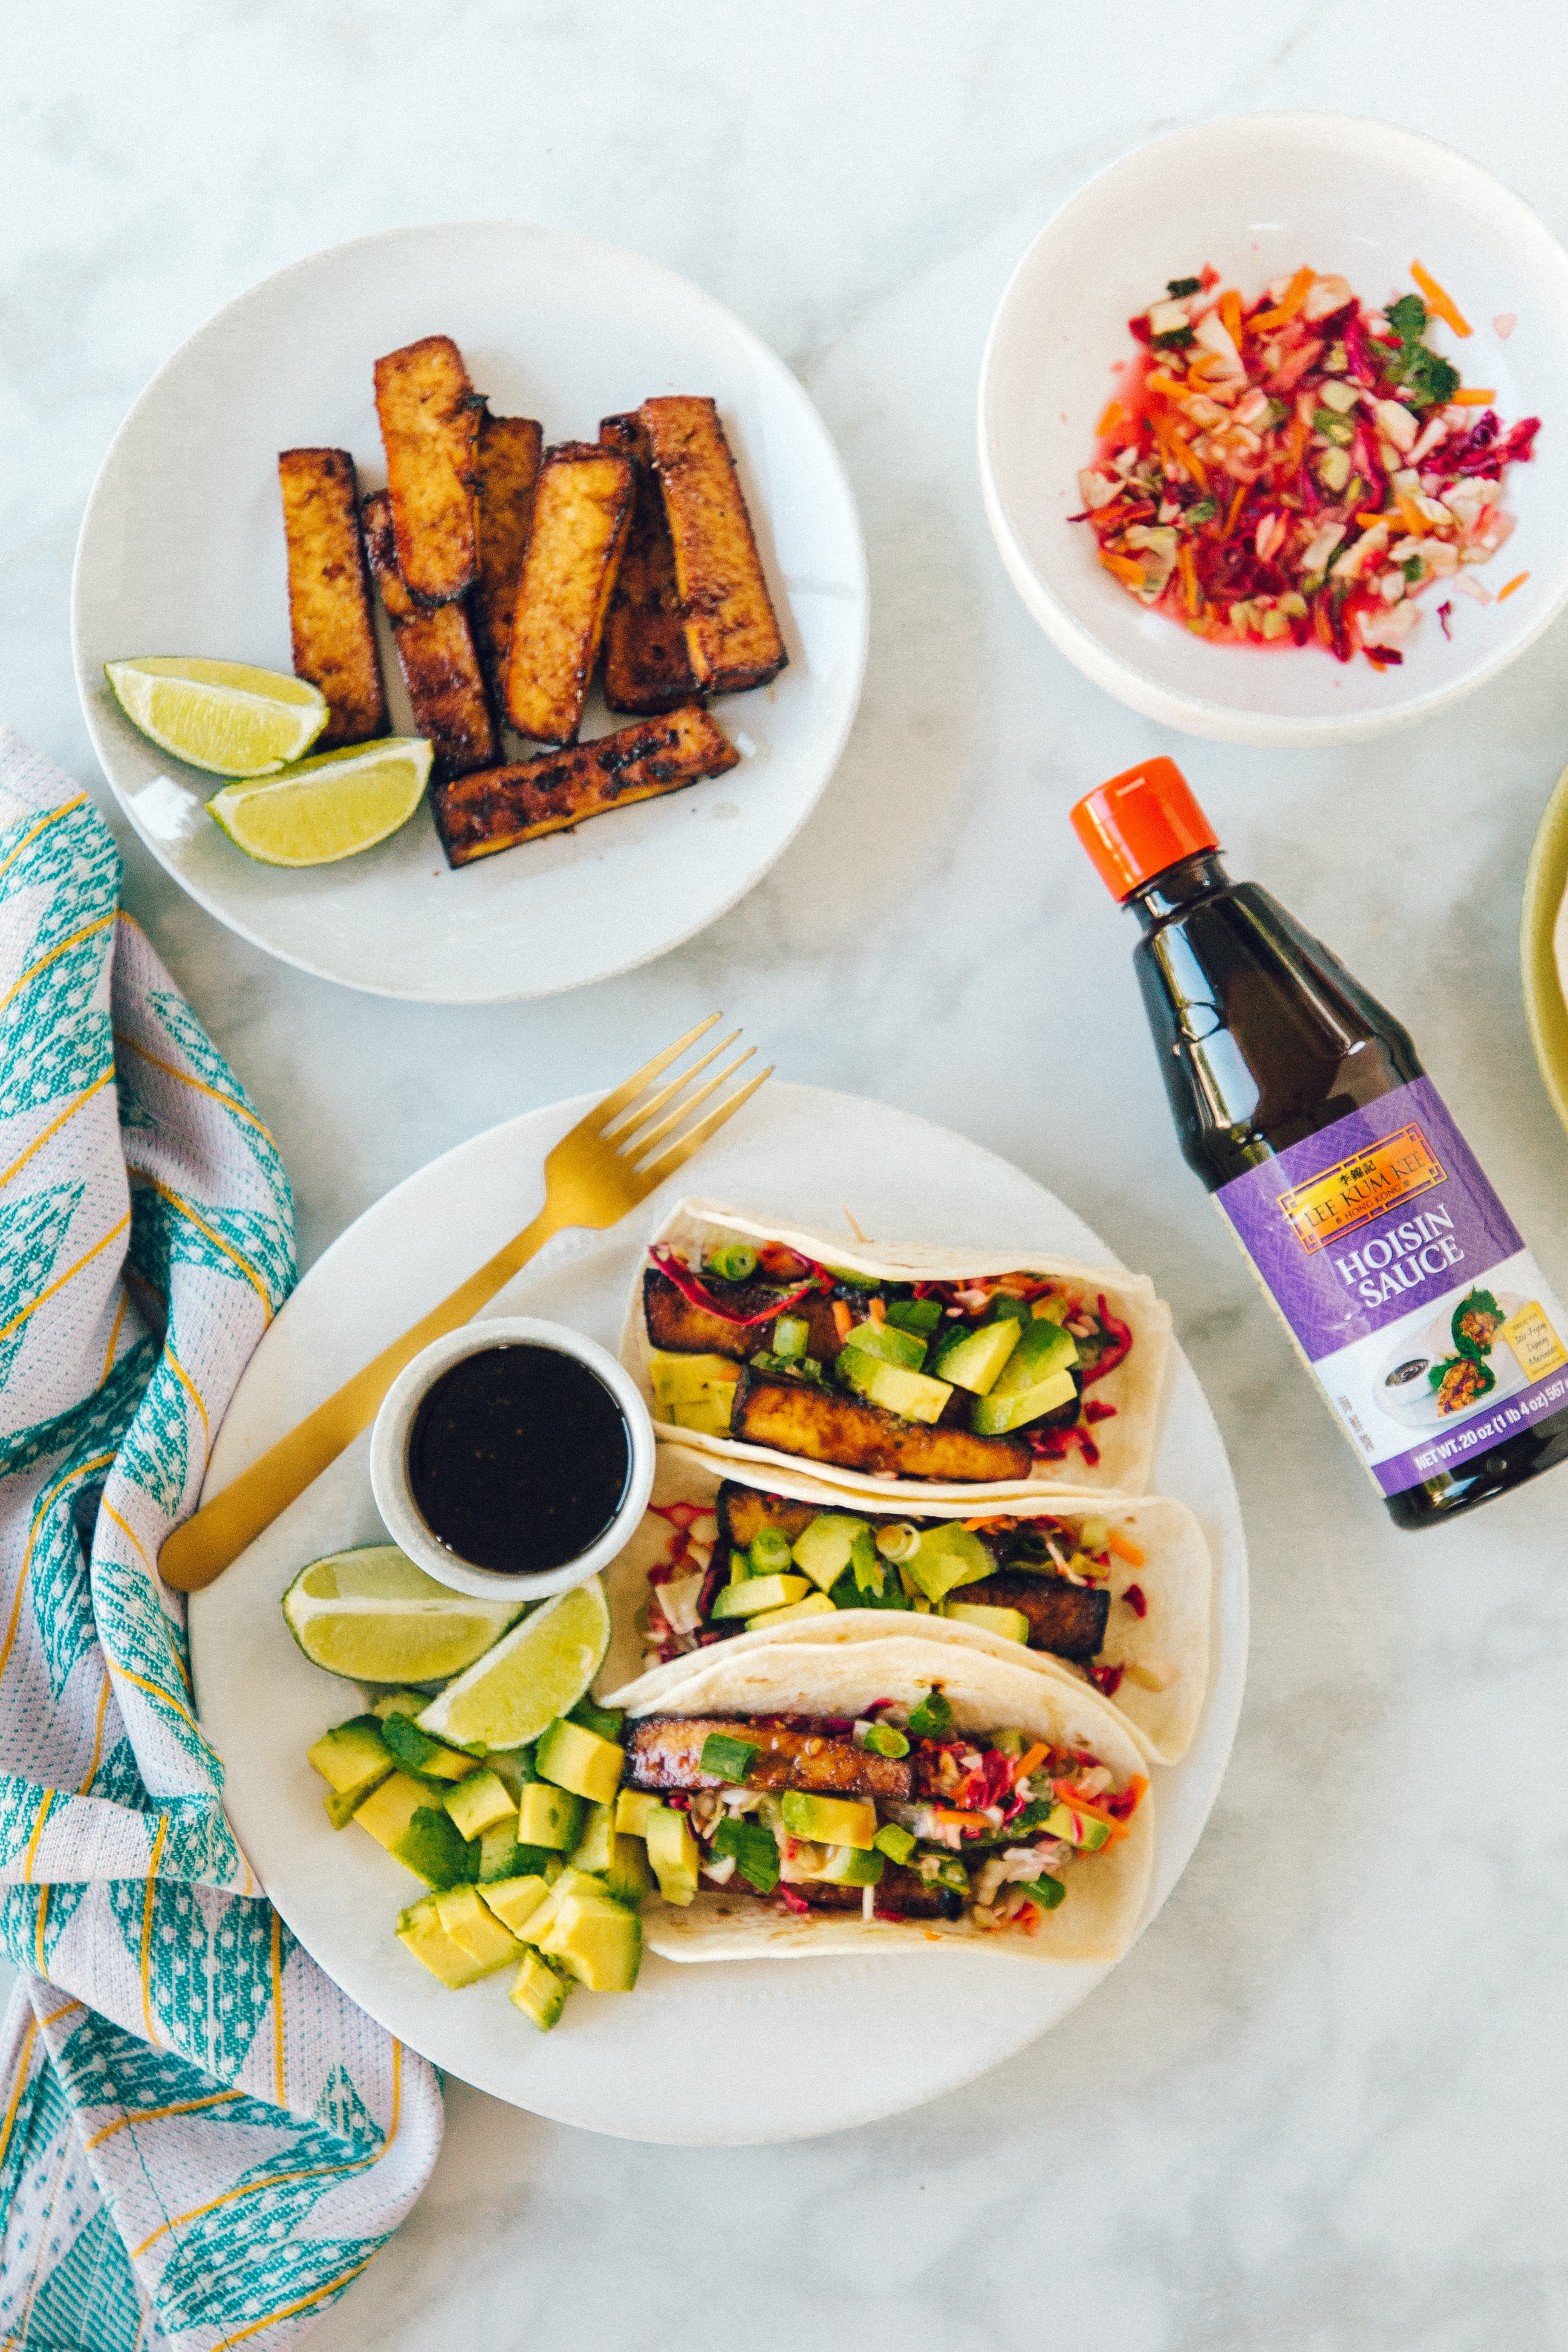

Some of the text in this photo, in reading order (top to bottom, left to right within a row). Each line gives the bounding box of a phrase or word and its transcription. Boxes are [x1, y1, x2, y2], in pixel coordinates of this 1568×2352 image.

[1304, 1152, 1426, 1227] LEE KUM KEE
[1339, 1160, 1376, 1186] 李錦記
[1344, 1186, 1402, 1219] HONG KONG
[1335, 1204, 1454, 1286] HOISIN
[1359, 1235, 1465, 1308] SAUCE
[1413, 1450, 1438, 1470] NET
[1436, 1438, 1463, 1459] WT.
[1459, 1430, 1478, 1449] 20
[1477, 1423, 1495, 1440] oz
[1492, 1413, 1507, 1433] (1
[1505, 1409, 1521, 1424] lb
[1520, 1401, 1530, 1415] 4
[1528, 1390, 1549, 1411] oz)
[1545, 1380, 1565, 1401] 567
